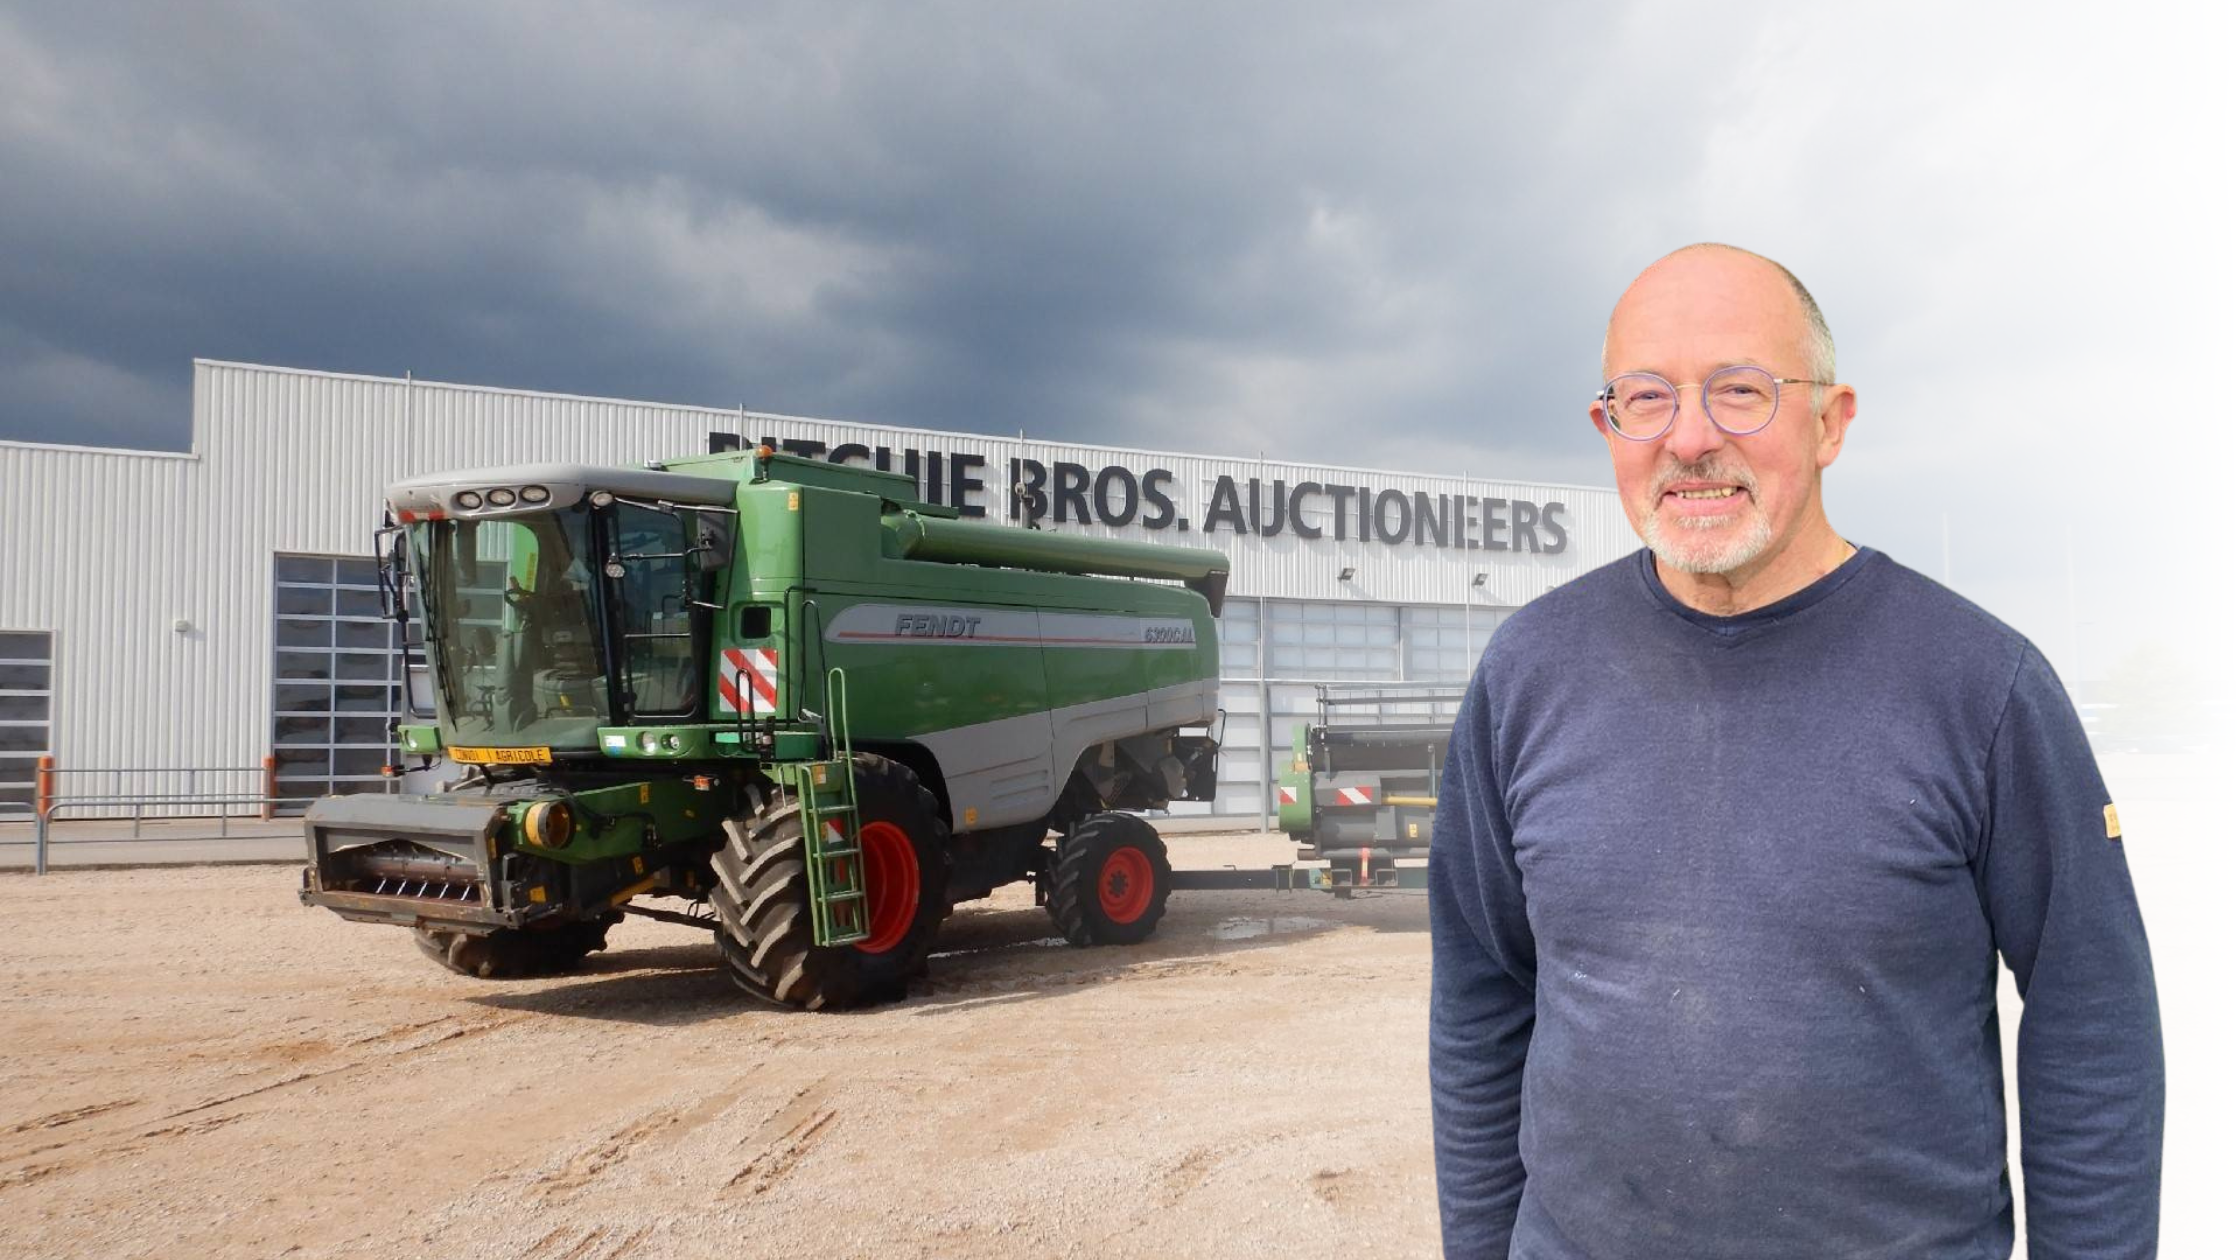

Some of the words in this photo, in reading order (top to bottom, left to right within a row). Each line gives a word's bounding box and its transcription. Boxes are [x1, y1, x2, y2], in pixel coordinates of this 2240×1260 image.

[1010, 457, 1189, 531] BROS.
[1203, 475, 1568, 554] AUCTIONEERS
[895, 614, 981, 638] FENDT
[496, 749, 545, 762] AGRICOLE
